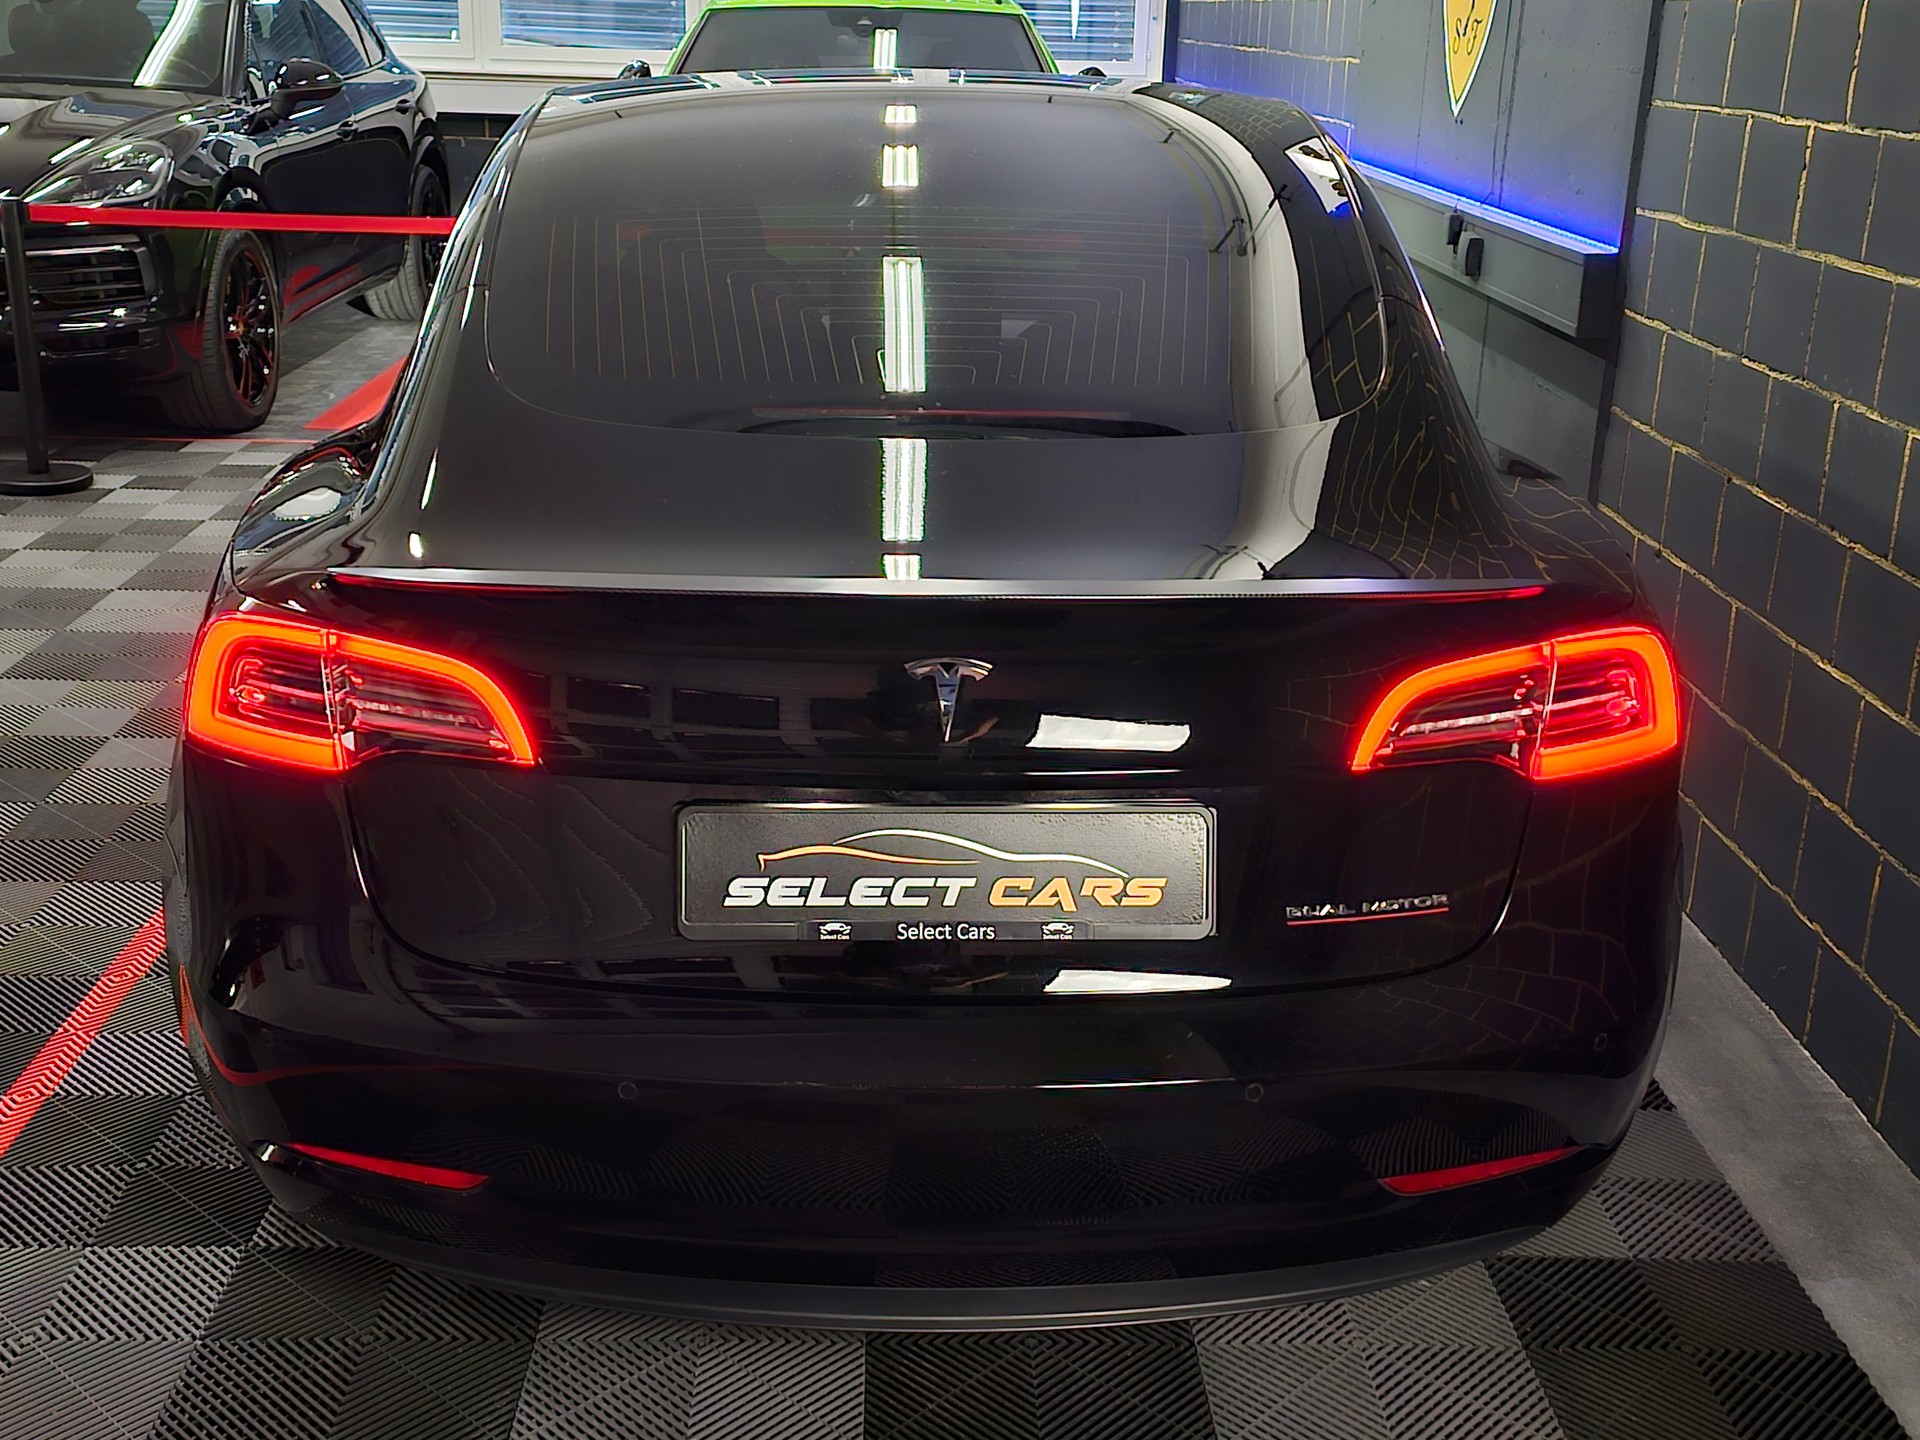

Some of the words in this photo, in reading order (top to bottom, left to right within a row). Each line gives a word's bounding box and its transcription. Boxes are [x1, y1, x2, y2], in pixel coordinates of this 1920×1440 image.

[723, 877, 977, 907] SELECT
[989, 877, 1168, 912] CARS
[1362, 894, 1449, 913] MOTOR
[897, 922, 952, 940] Select
[957, 923, 995, 940] Cars
